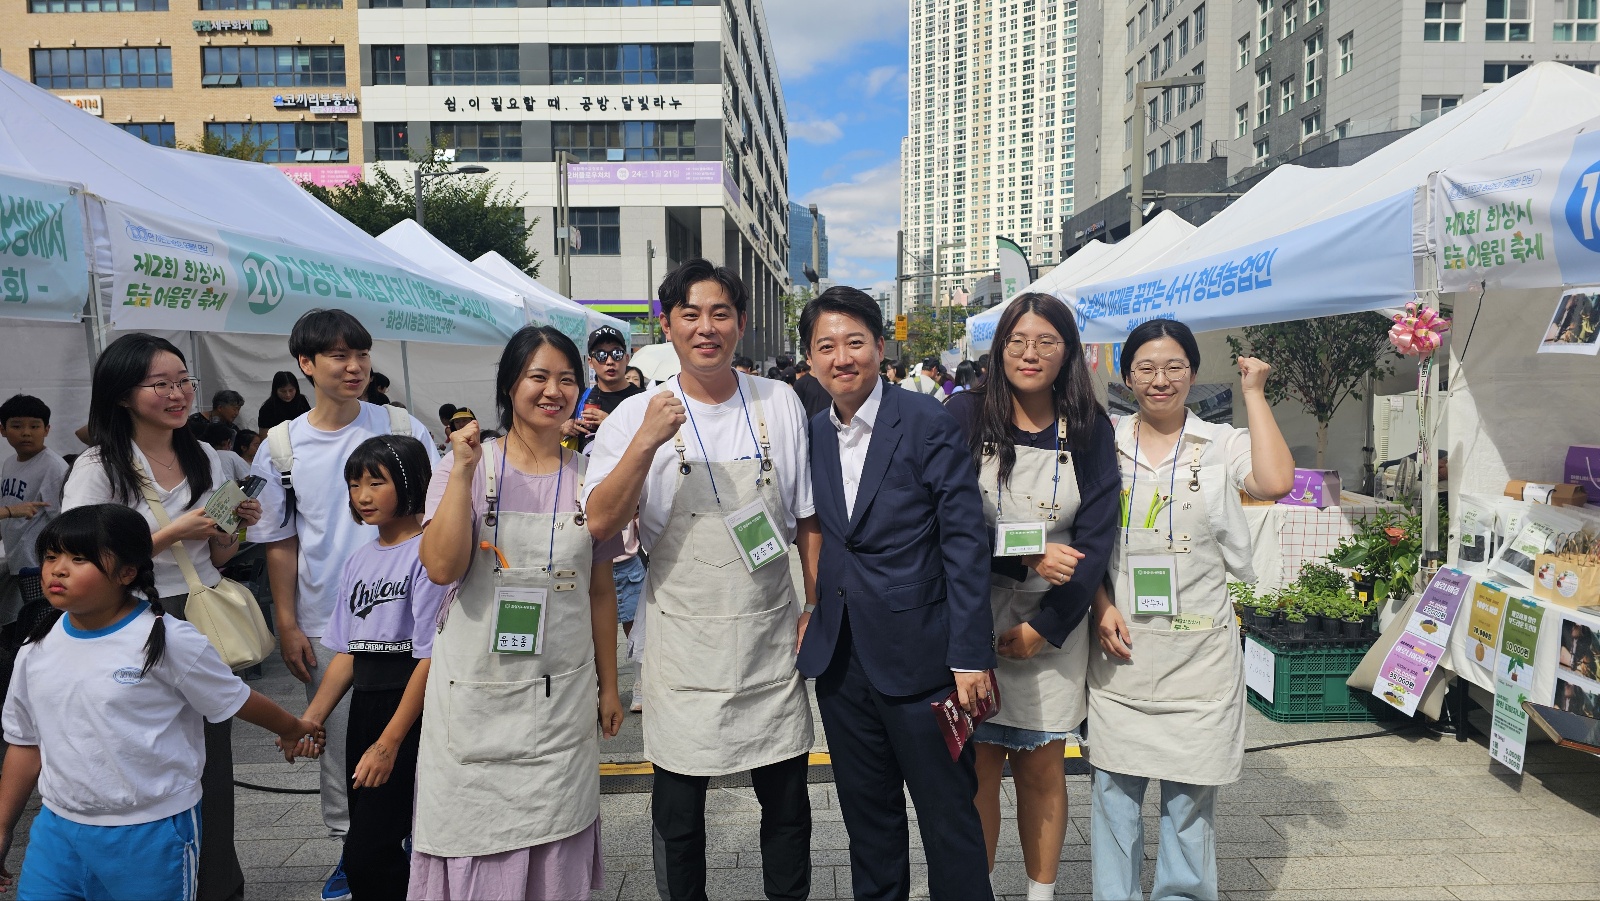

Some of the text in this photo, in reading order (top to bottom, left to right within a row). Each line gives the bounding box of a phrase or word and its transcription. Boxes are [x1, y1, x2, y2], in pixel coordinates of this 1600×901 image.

[284, 93, 356, 107] 코끼리부동산
[490, 95, 535, 111] 필요할
[1445, 198, 1533, 236] 제2회 화성시
[1581, 171, 1600, 240] 1
[1467, 238, 1506, 268] 어울림
[1510, 230, 1544, 264] 축제
[0, 266, 29, 304] 회
[133, 253, 226, 286] 제2회 화성시
[243, 258, 281, 306] 20
[276, 255, 352, 299] 다양한
[1107, 285, 1136, 316] 미래를
[1132, 279, 1167, 313] 꿈꾸는
[1166, 271, 1198, 307] 4-H
[1193, 247, 1278, 302] 청년농업인
[154, 286, 197, 310] 어울림
[198, 287, 228, 311] 축제
[385, 642, 411, 651] PEACHES
